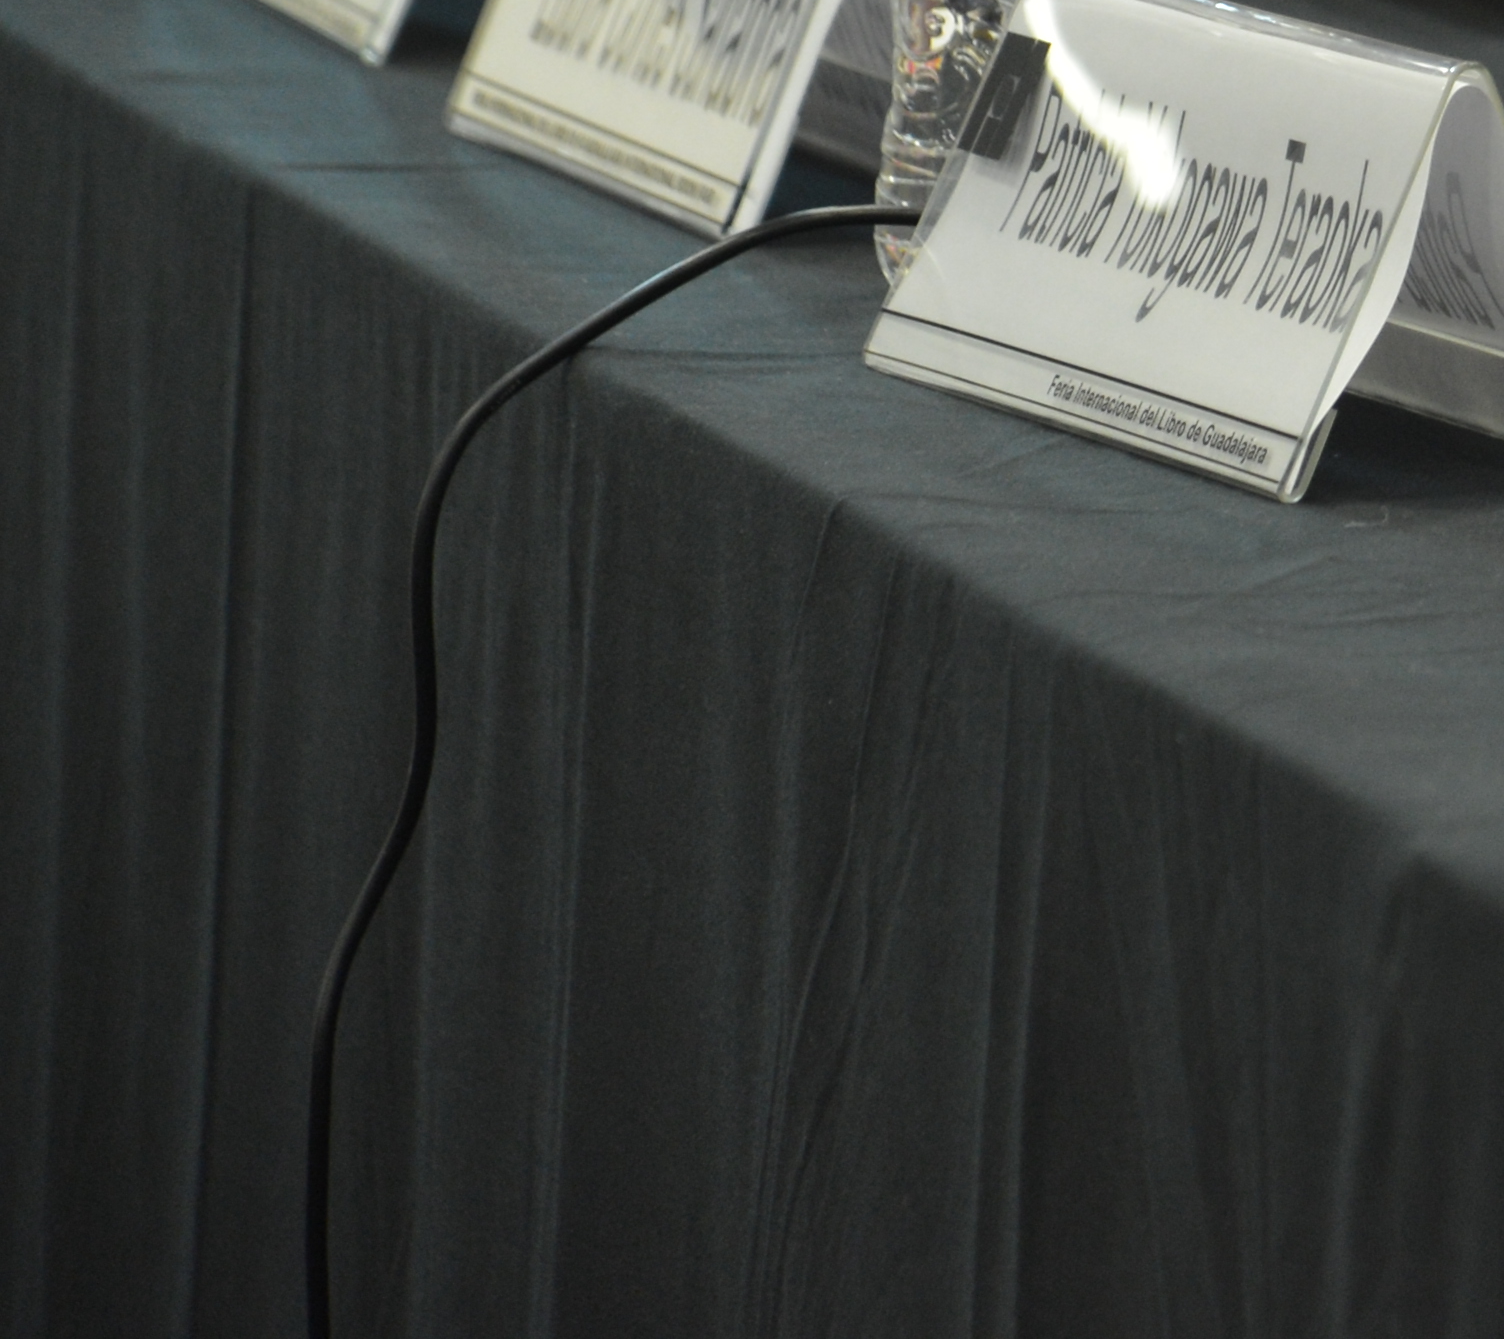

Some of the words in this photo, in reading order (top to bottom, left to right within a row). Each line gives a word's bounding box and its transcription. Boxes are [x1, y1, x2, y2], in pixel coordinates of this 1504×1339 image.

[999, 80, 1129, 259] Patricia
[1243, 138, 1384, 333] Teraoka
[1048, 374, 1075, 401] Feria
[1074, 381, 1140, 422] Internacional
[1140, 406, 1158, 427] del
[1156, 409, 1187, 438] Libro
[1187, 424, 1202, 442] de
[1202, 424, 1268, 465] Guadalajara
